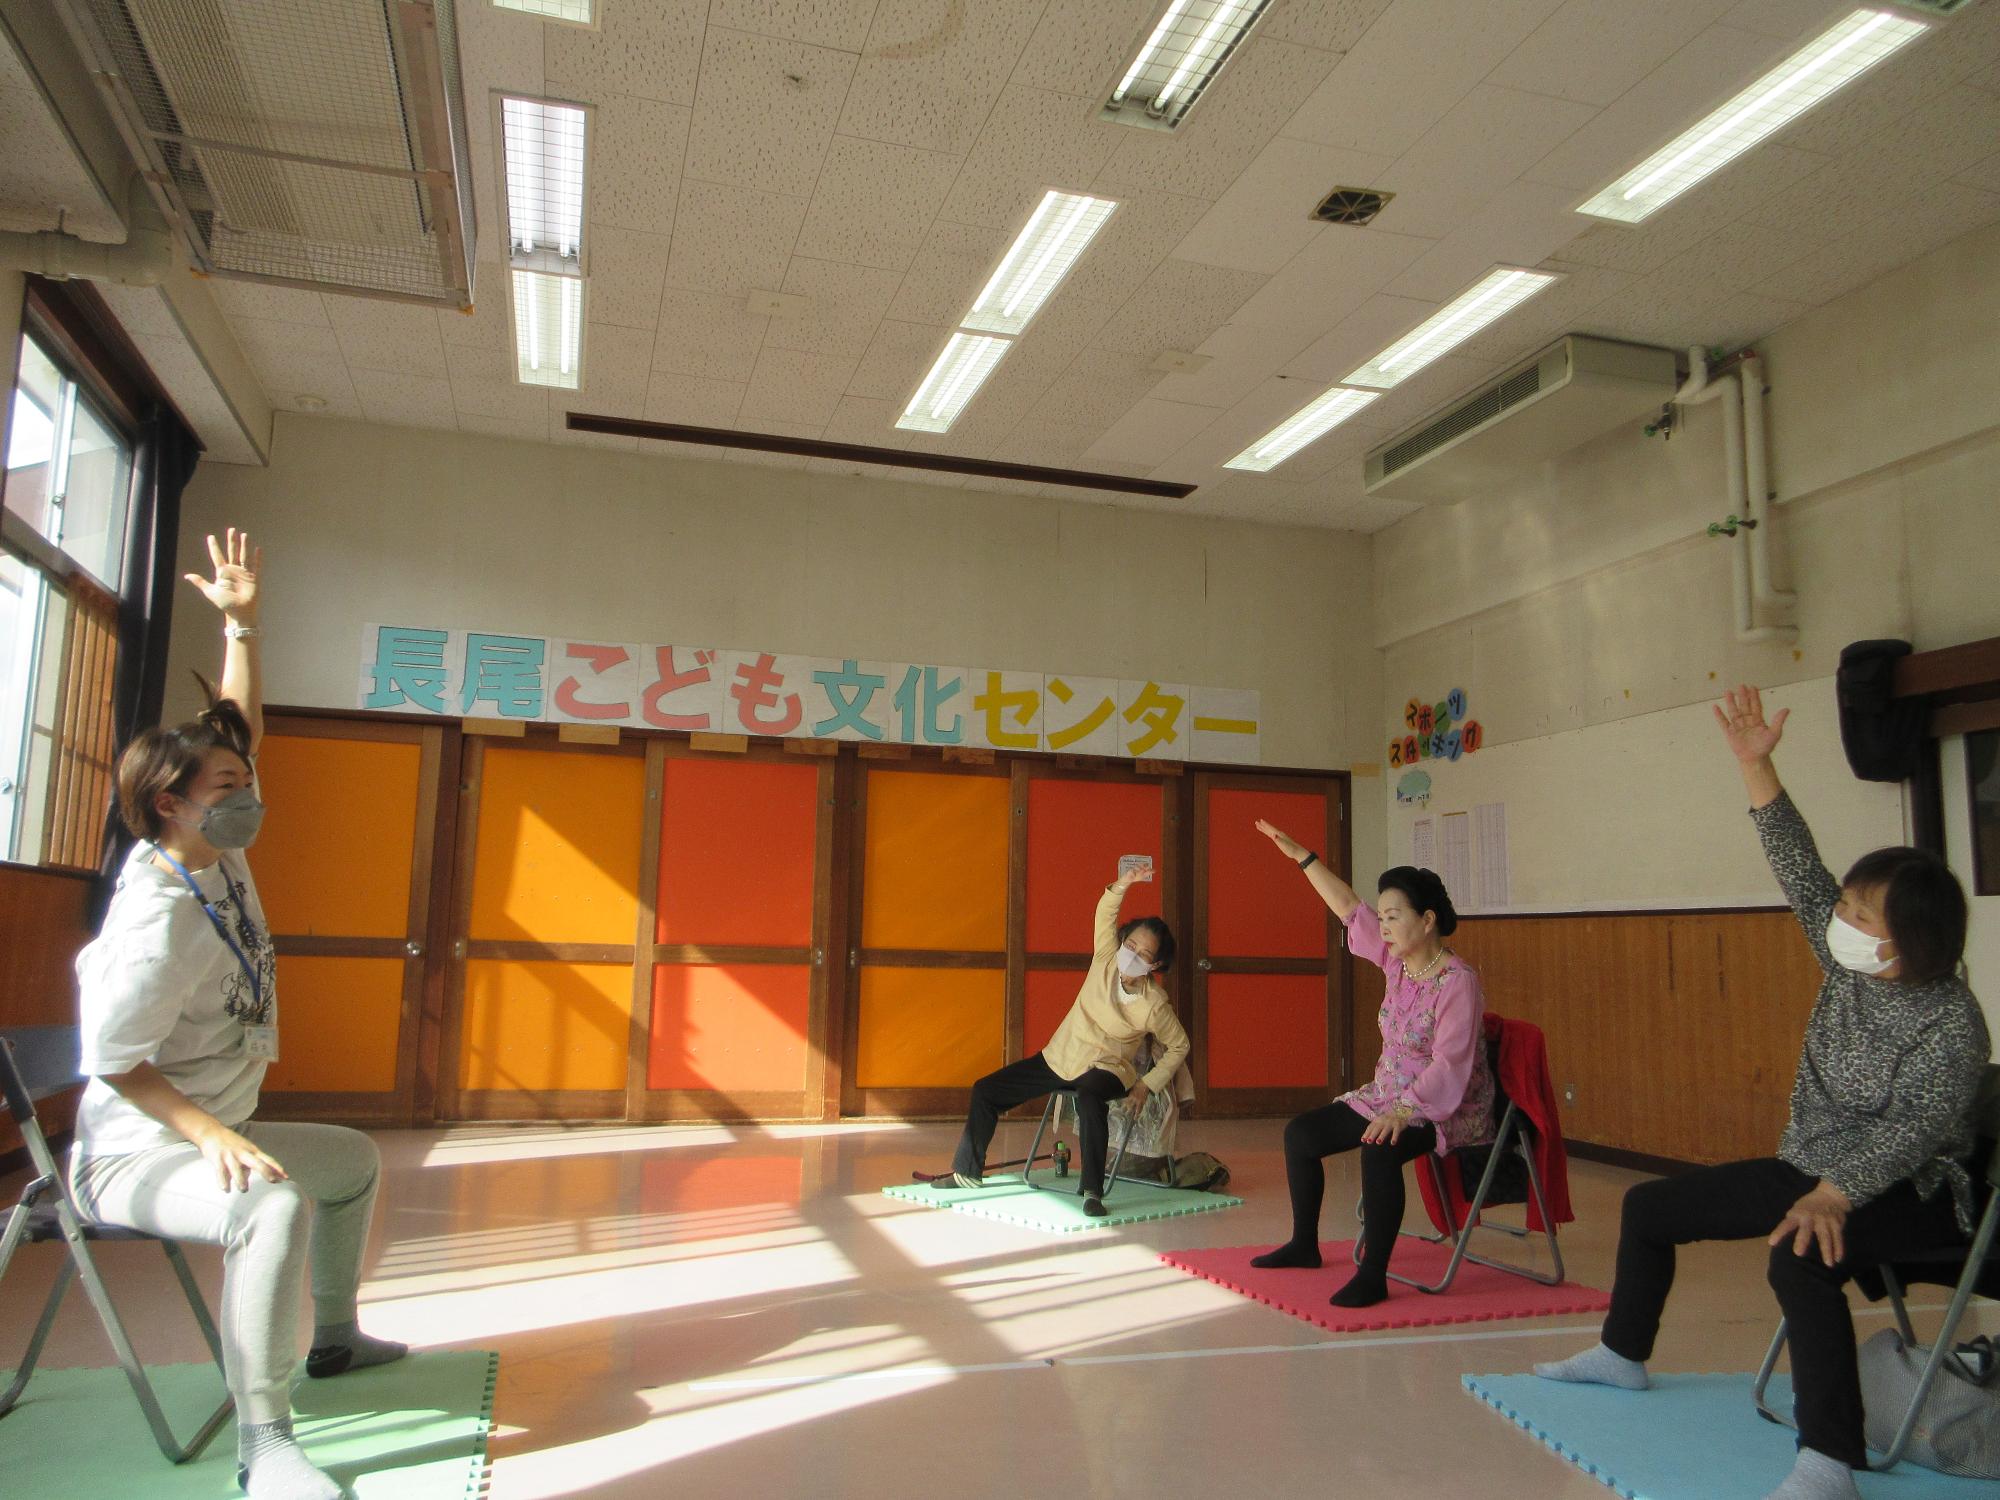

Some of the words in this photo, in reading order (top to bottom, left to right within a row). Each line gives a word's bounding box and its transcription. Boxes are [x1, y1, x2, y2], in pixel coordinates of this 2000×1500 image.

[363, 625, 1257, 757] 長尾こども文化センター
